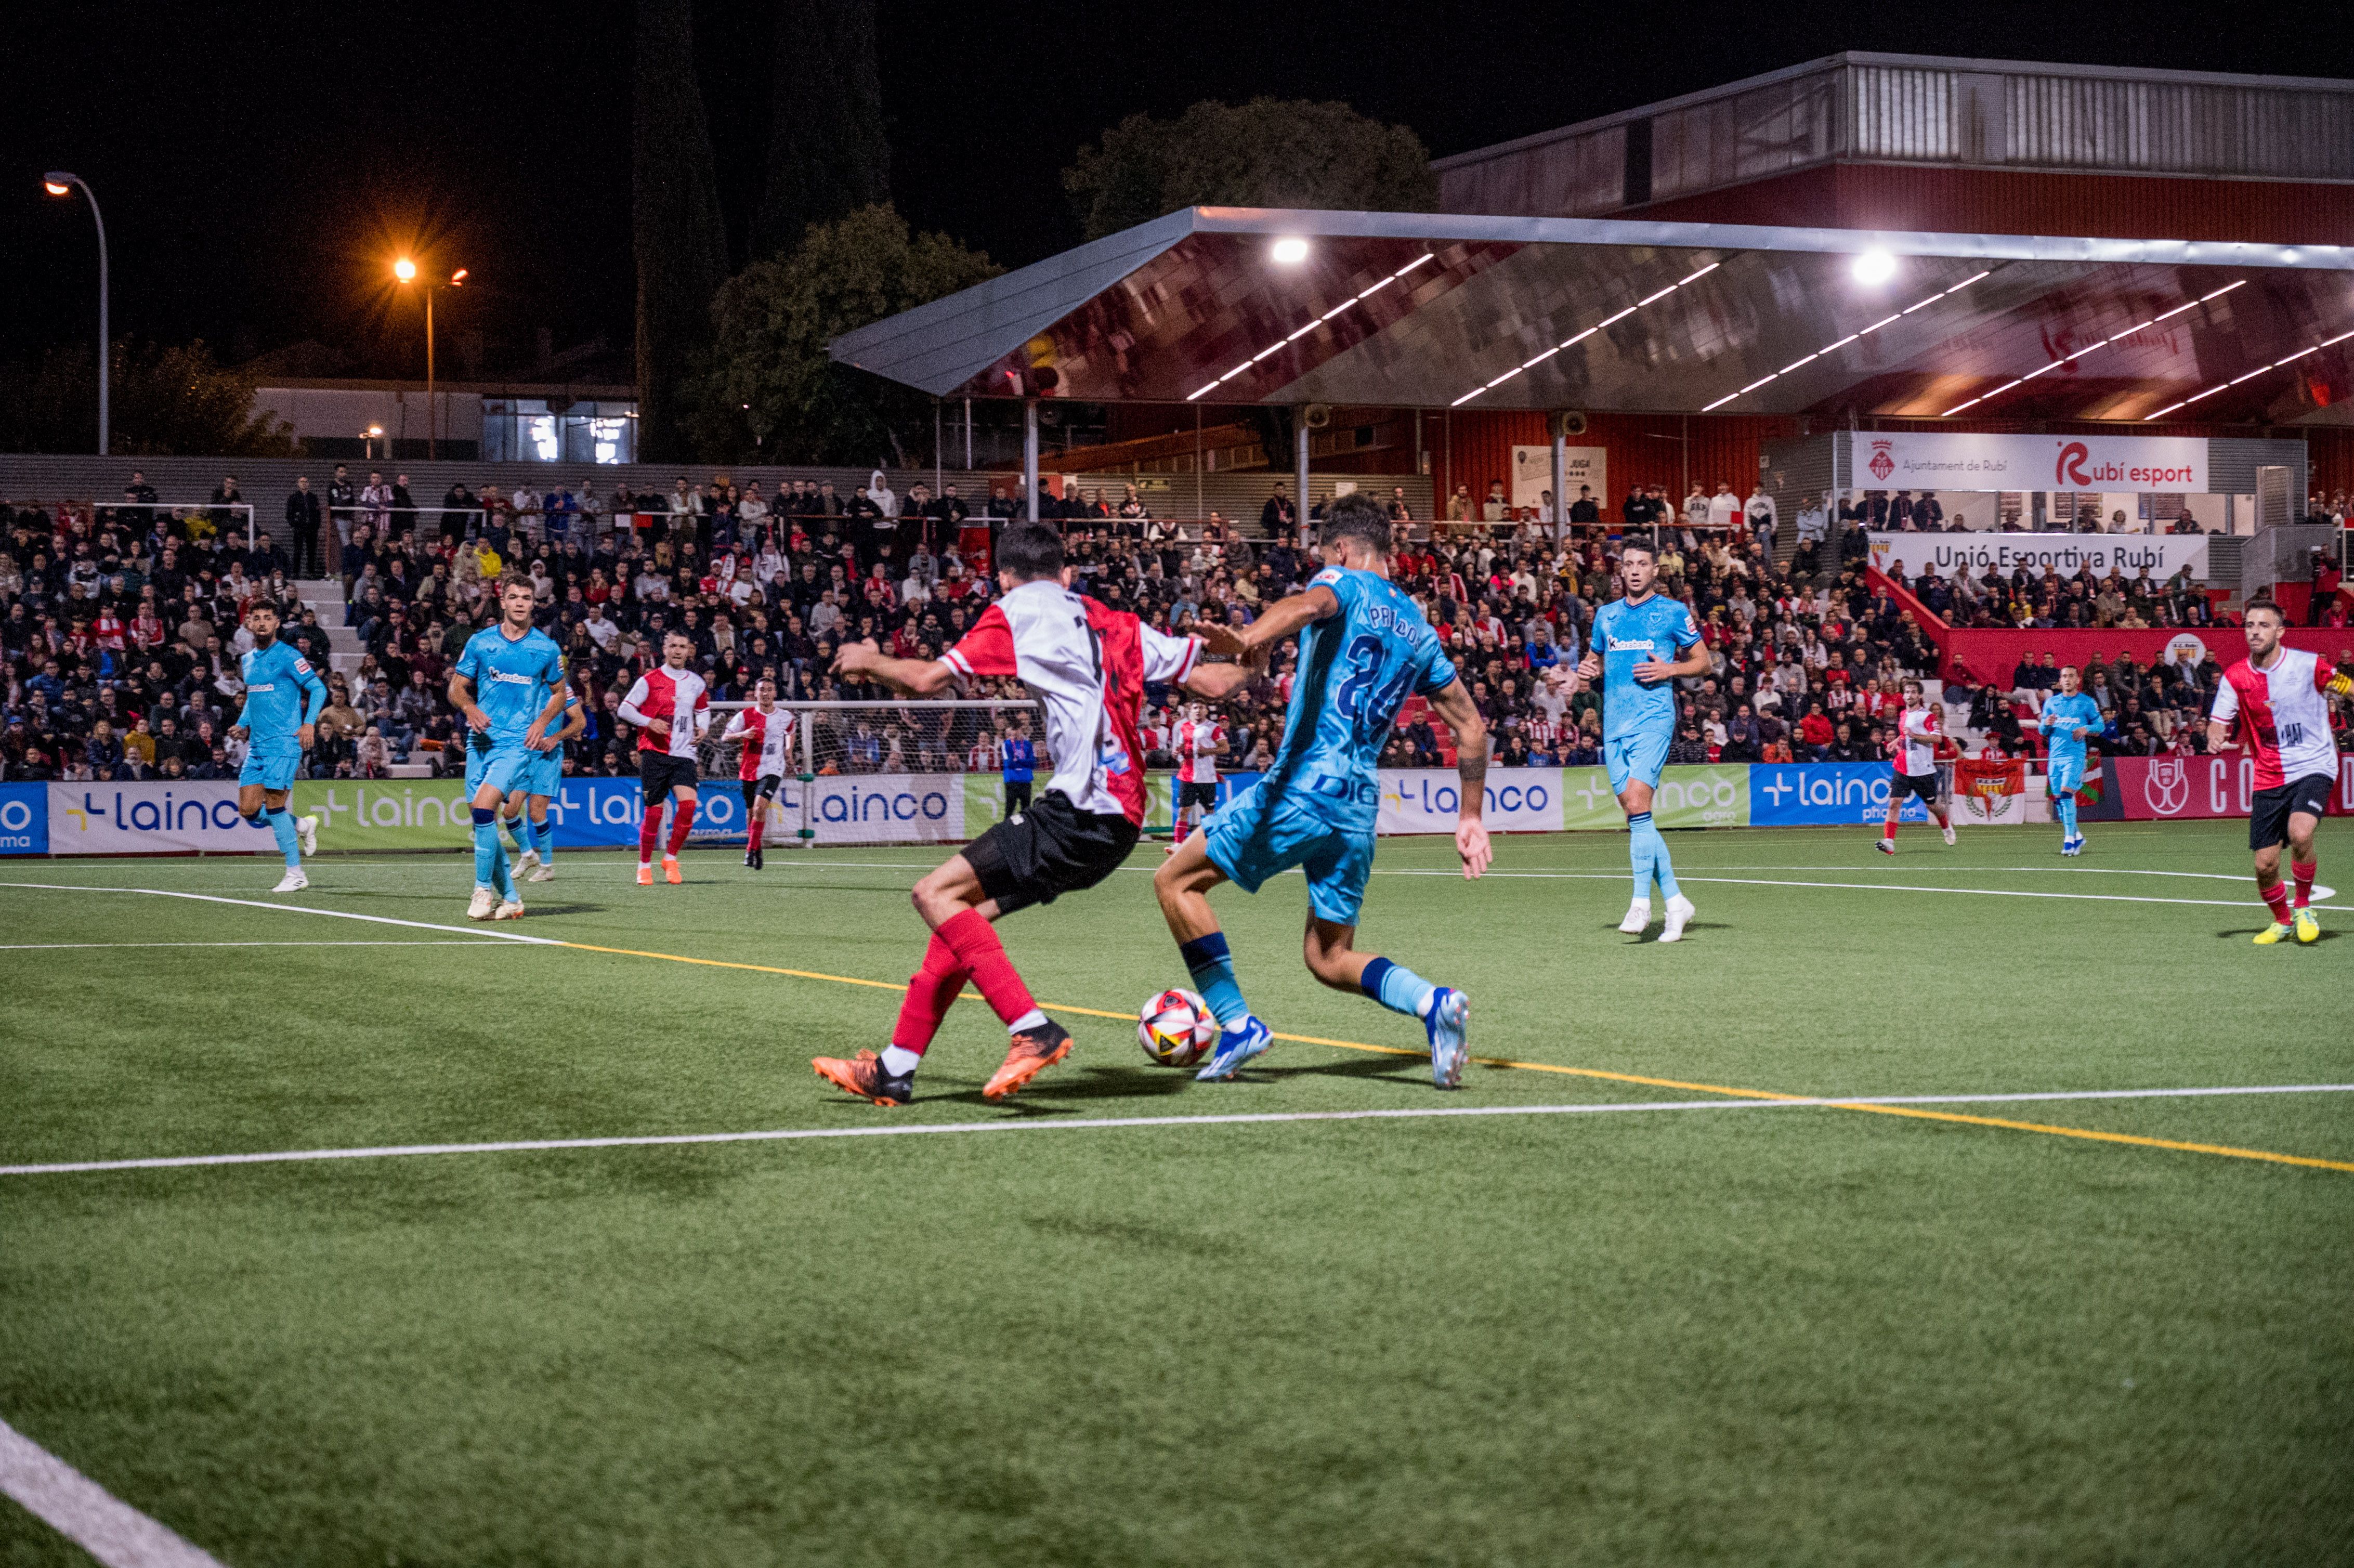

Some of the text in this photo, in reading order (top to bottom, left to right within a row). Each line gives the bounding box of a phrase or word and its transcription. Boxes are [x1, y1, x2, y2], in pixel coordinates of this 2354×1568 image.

[1903, 460, 2007, 473] Ajuntament de Rubí
[2056, 441, 2192, 487] Rubí esport
[1935, 545, 2164, 568] Unió Esportiva Rubí
[116, 791, 268, 830] lainc
[357, 788, 505, 827] lainc
[812, 775, 947, 823] ainco
[1422, 779, 1548, 813] laco
[1863, 805, 1916, 821] phama
